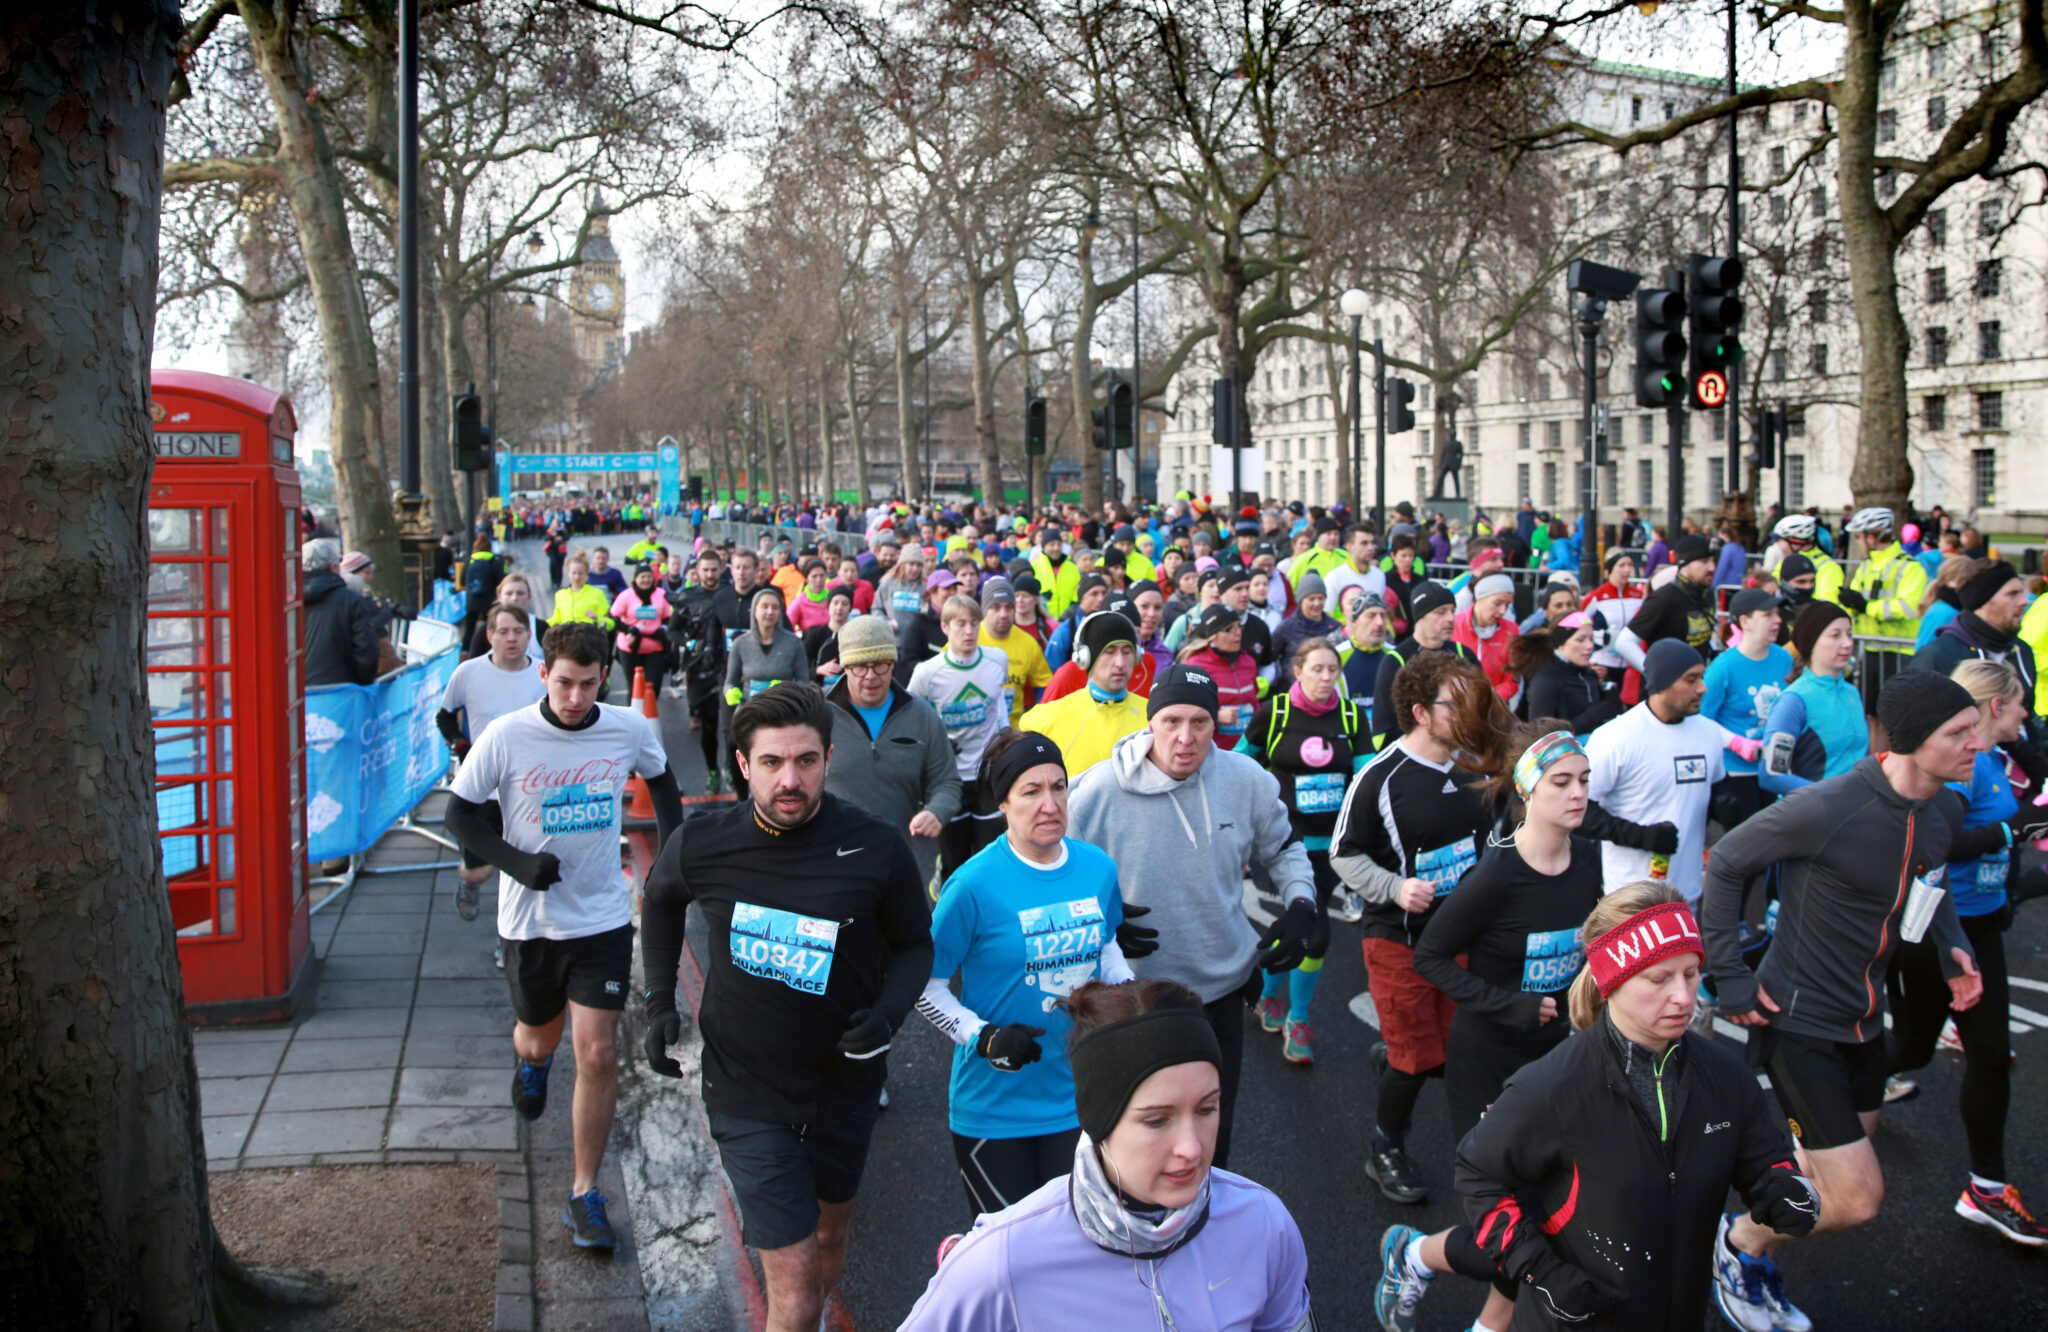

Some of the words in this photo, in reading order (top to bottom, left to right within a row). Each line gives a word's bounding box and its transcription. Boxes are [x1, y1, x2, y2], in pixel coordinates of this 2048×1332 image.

[565, 456, 606, 468] START
[1299, 788, 1344, 805] 08496
[542, 820, 613, 834] HUMANRACE
[546, 801, 611, 825] 09503
[1033, 925, 1102, 960] 12274
[1605, 912, 1699, 968] WILL
[735, 936, 828, 977] 10847
[732, 955, 825, 992] HUMANRACE
